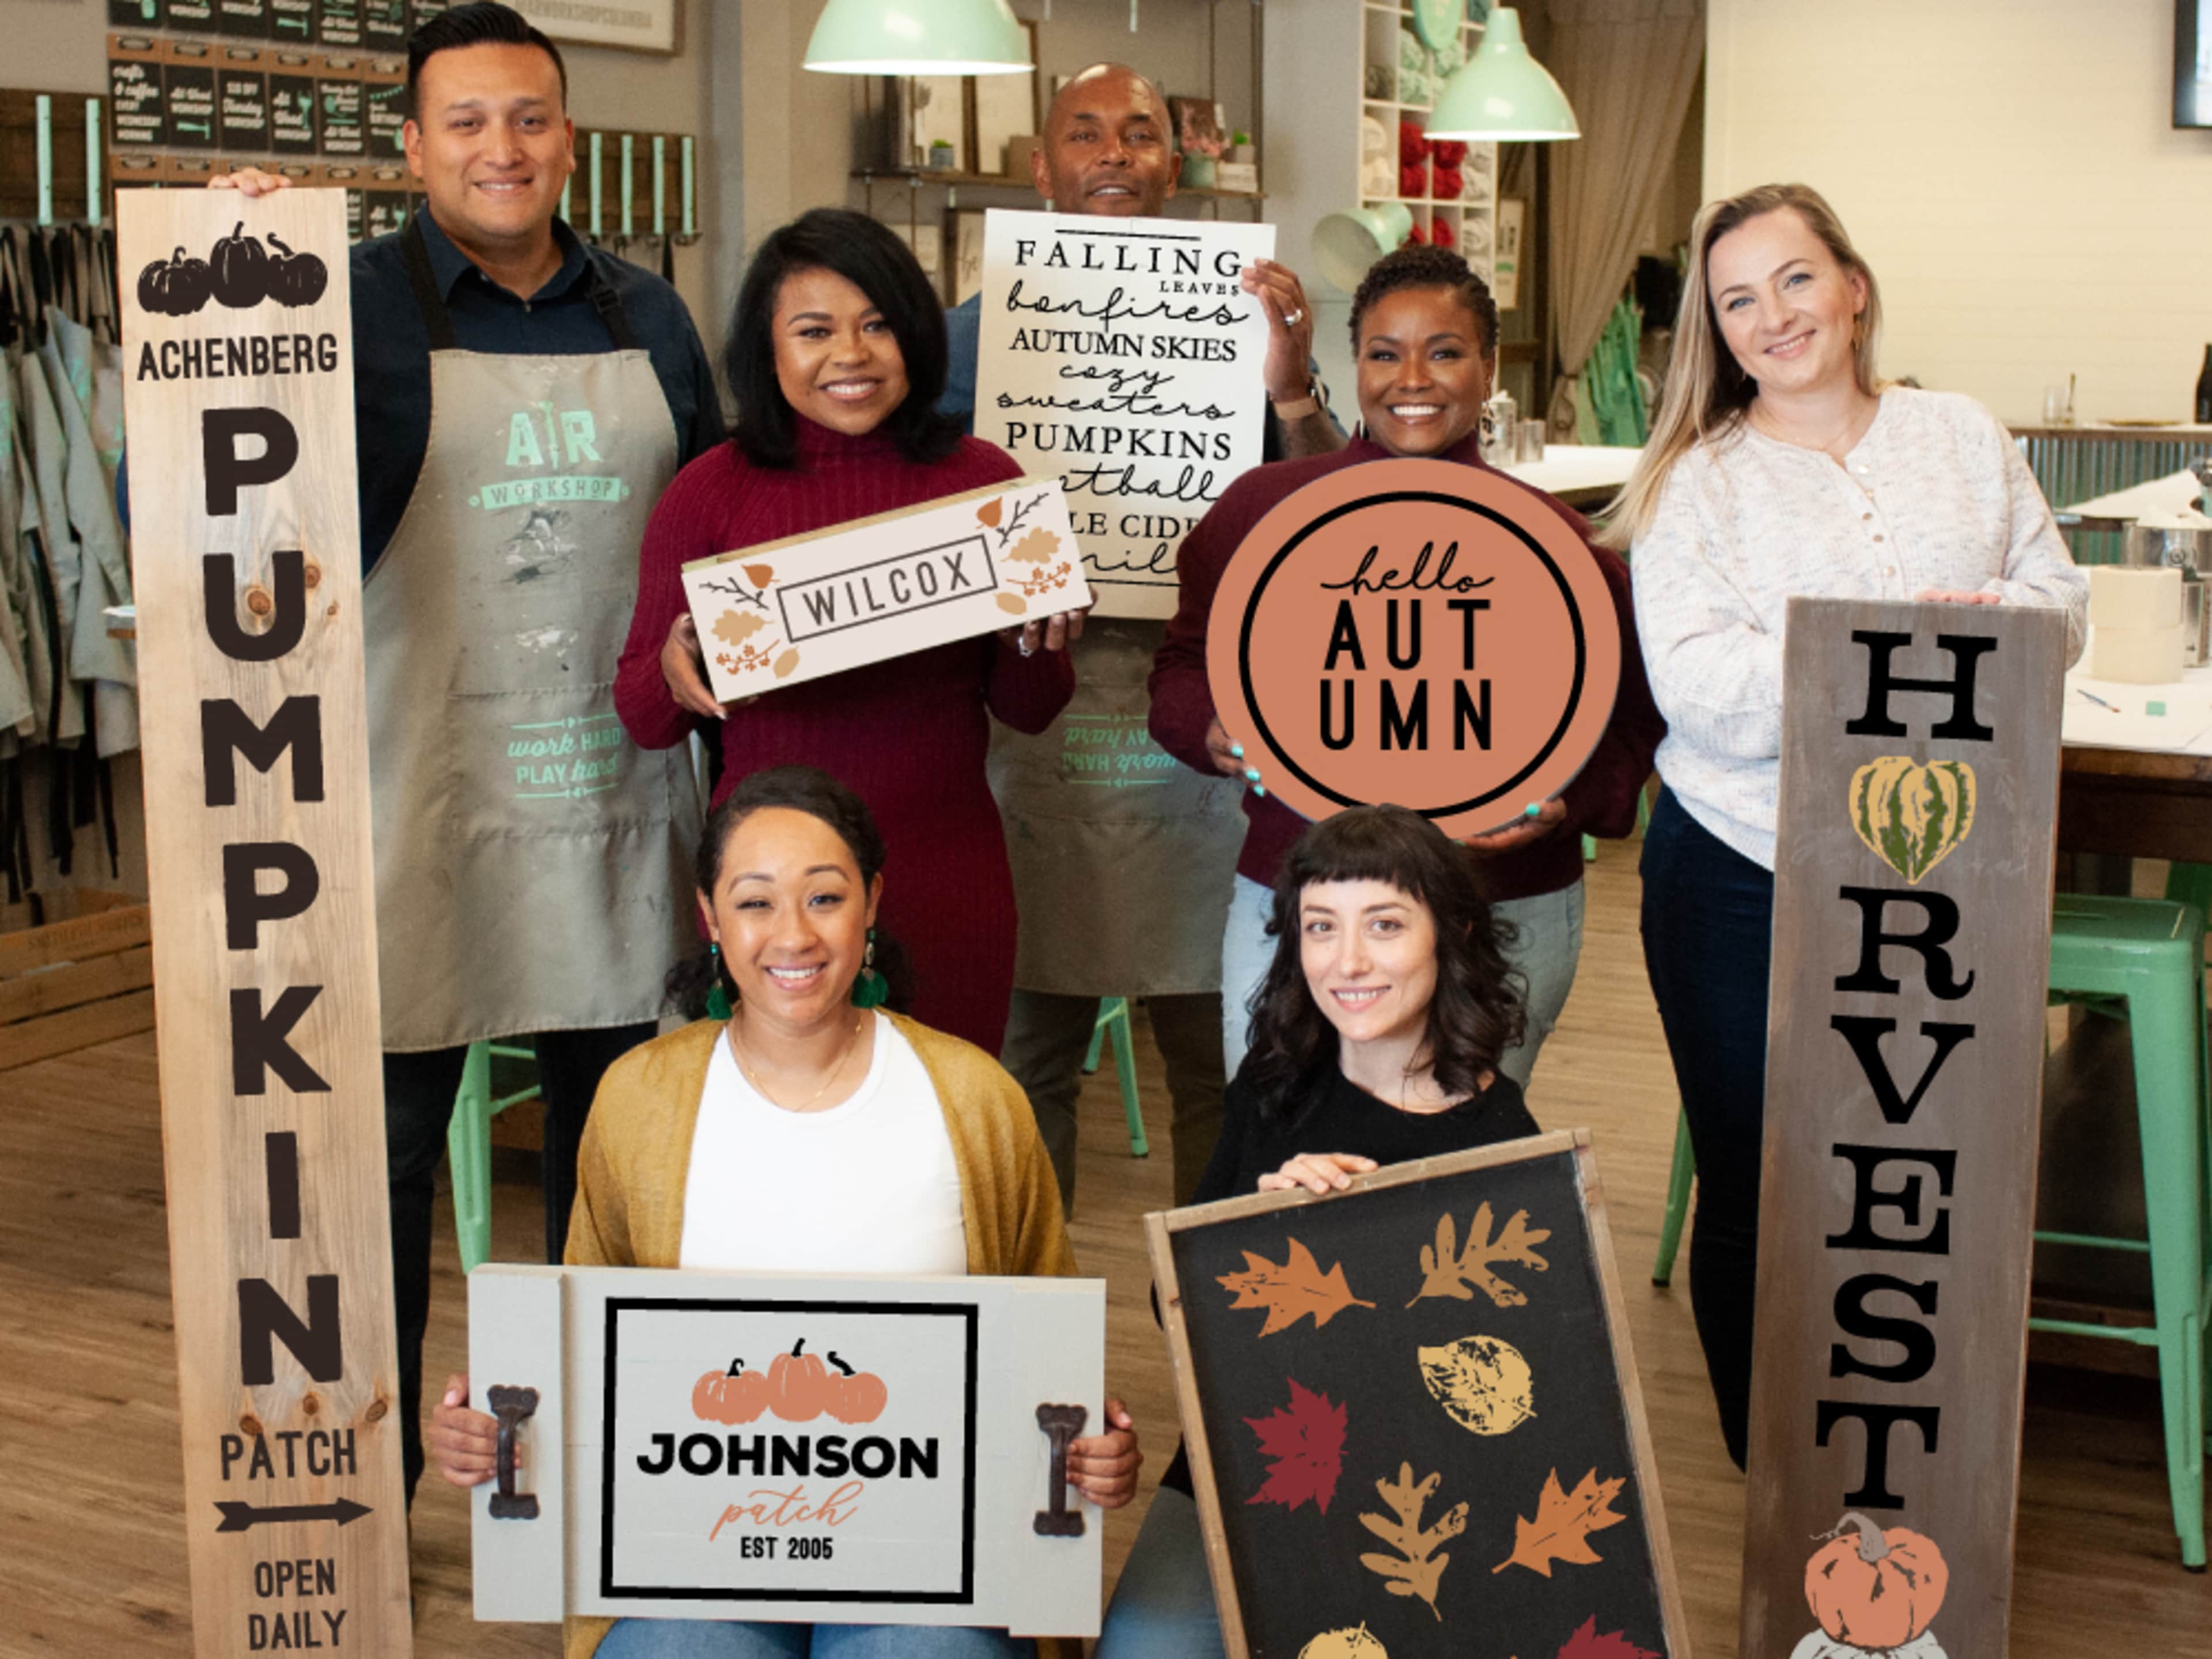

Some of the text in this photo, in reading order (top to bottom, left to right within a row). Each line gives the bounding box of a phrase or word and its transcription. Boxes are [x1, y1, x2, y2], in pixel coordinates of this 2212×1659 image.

[1015, 240, 1242, 278] FALLING
[1006, 279, 1251, 334] bonfires
[1159, 280, 1240, 296] LEAVES
[137, 332, 338, 381] ACHENBERG
[1009, 327, 1237, 362] AUTUMN SKIES
[1059, 364, 1176, 394] cozy
[996, 390, 1236, 421] sweaters
[1005, 422, 1232, 461] PUMPKINS
[490, 479, 614, 505] WORKSHOP
[1320, 540, 1495, 596] hello
[802, 551, 971, 627] WILCOX
[1323, 598, 1491, 671] AUT
[1320, 678, 1491, 751] UMN
[507, 727, 622, 757] work HARD
[1124, 728, 1149, 746] AY
[516, 751, 619, 785] PLAY hard
[200, 407, 342, 1386] PUMPKIN
[220, 1428, 357, 1481] PATCH
[636, 1433, 939, 1479] JOHNSON
[709, 1479, 864, 1543] patch
[740, 1536, 834, 1560] EST 2005
[254, 1557, 336, 1598] OPEN
[248, 1609, 347, 1650] DAILY
